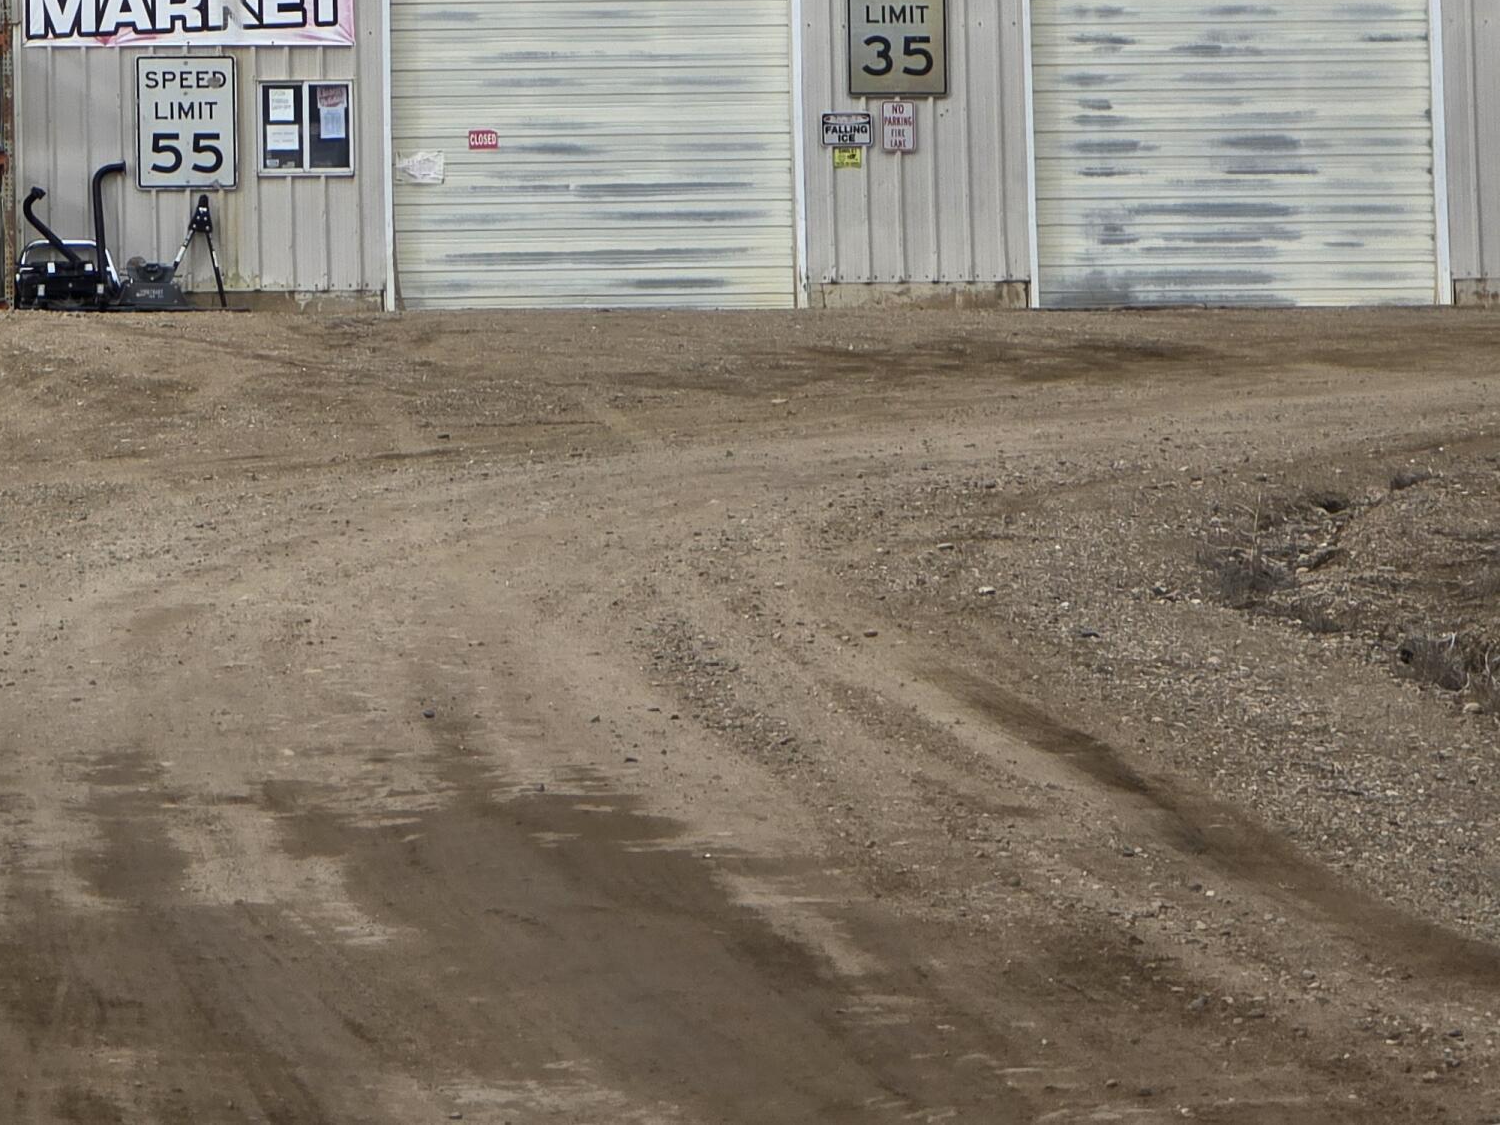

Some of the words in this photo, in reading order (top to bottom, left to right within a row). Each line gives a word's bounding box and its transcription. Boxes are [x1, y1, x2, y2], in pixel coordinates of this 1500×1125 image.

[866, 5, 929, 23] LIMIT
[862, 35, 933, 76] 35
[145, 71, 226, 89] SPEED
[154, 102, 217, 119] LIMIT
[892, 104, 904, 114] NO
[884, 117, 912, 126] PARKING
[825, 125, 867, 134] FALLING
[891, 129, 905, 137] FIRE
[469, 133, 496, 145] CLOSED
[838, 134, 855, 142] ICE
[891, 139, 906, 147] LANE
[151, 133, 223, 173] 55
